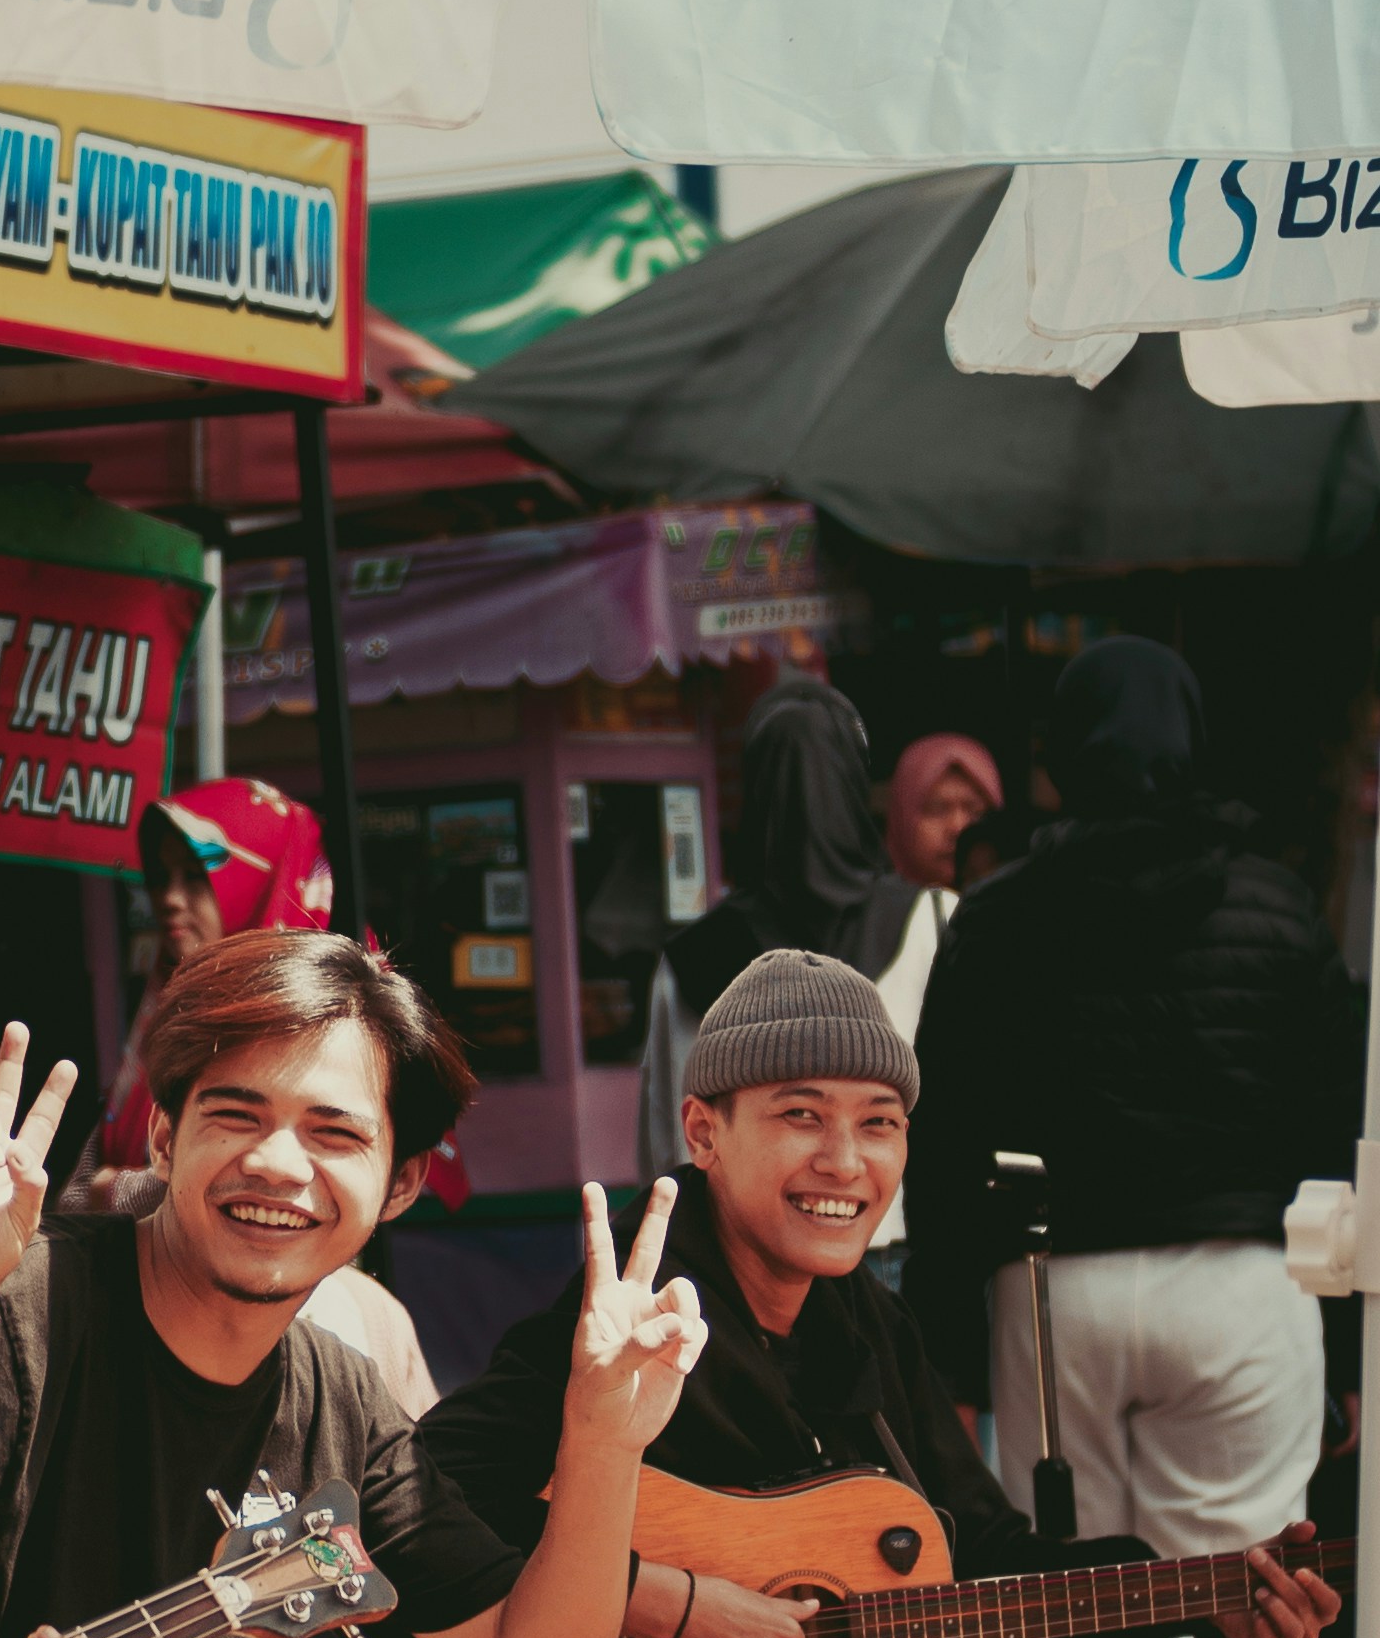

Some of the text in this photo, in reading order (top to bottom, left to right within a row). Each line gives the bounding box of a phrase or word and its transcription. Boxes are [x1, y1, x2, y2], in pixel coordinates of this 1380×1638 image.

[74, 146, 168, 272] KUPAT
[173, 168, 243, 288] TAHU
[248, 185, 300, 298] PAK
[305, 198, 332, 306] JO
[1277, 157, 1380, 239] Biz
[11, 621, 150, 742] TAHU
[3, 761, 134, 826] ALAMI
